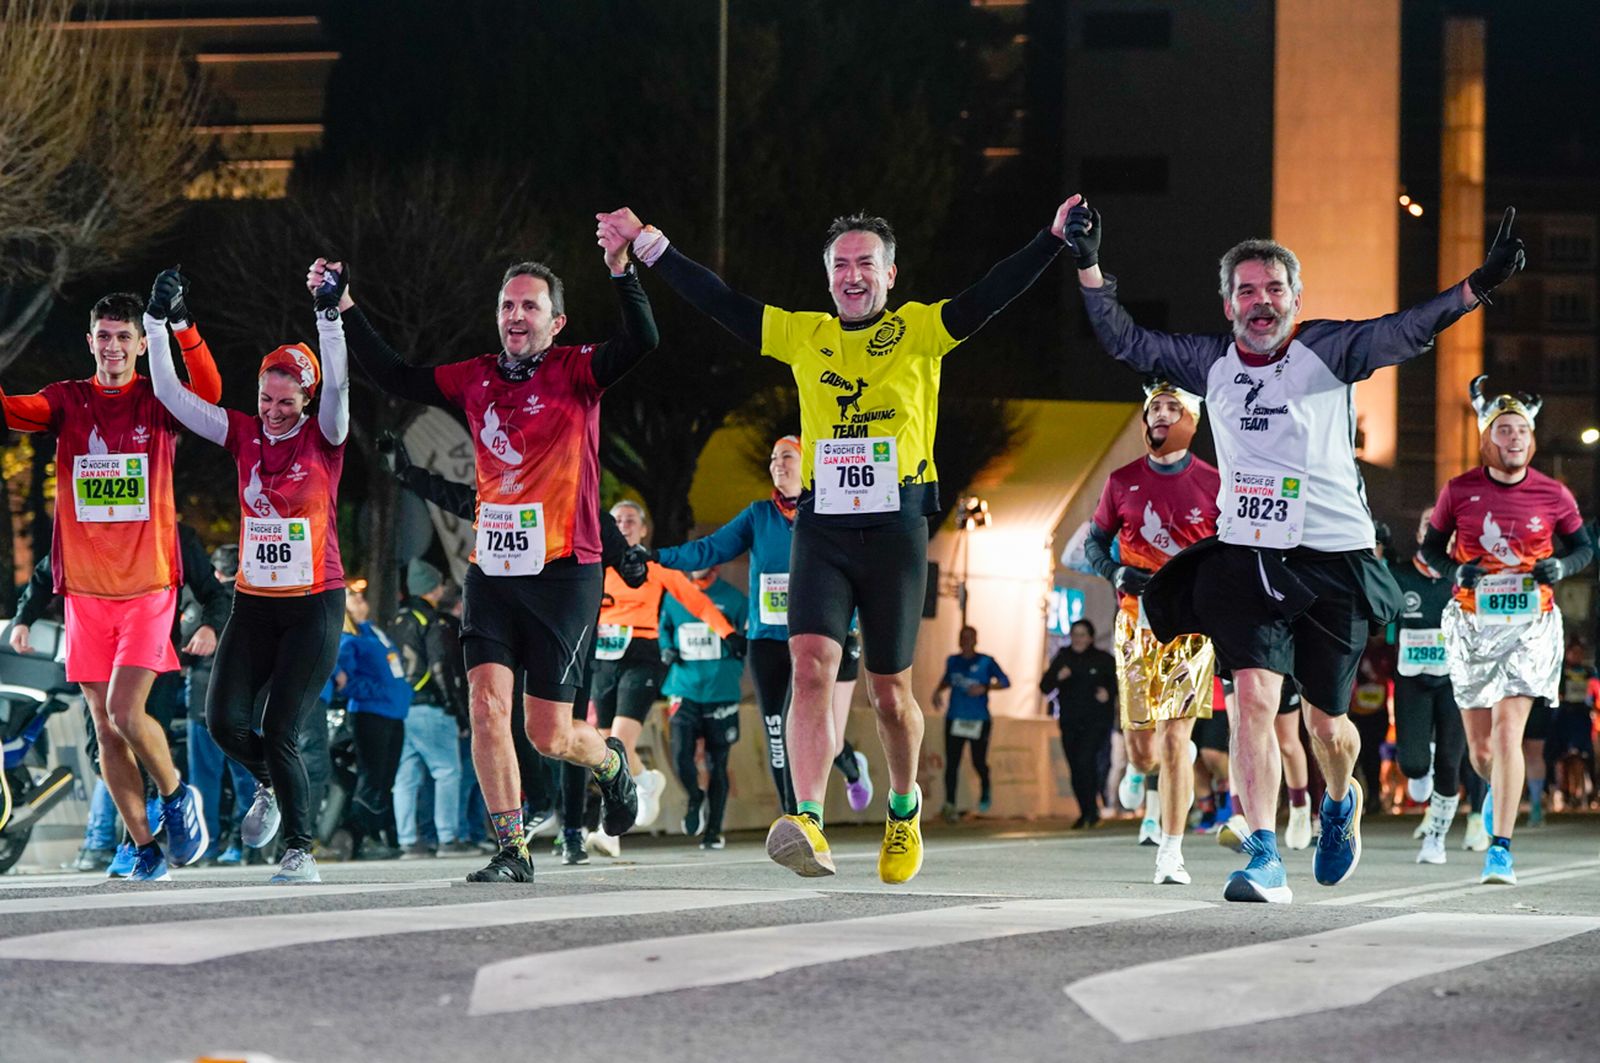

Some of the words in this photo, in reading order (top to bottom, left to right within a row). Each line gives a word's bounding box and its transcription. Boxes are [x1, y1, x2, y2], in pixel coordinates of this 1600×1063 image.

[851, 408, 895, 423] RUNNING
[832, 424, 868, 438] TEAM
[1240, 417, 1268, 431] TEAM
[492, 436, 508, 455] 43
[856, 446, 866, 454] DE
[836, 465, 875, 488] 766
[1242, 477, 1264, 485] NOCHE
[1264, 478, 1276, 487] DE
[82, 478, 139, 498] 12429
[1234, 485, 1248, 494] SAN
[254, 498, 271, 517] 43
[1237, 495, 1288, 522] 3823
[504, 513, 513, 521] DE
[486, 530, 529, 551] 7245
[1152, 533, 1170, 549] 43
[256, 542, 292, 563] 486
[1491, 542, 1508, 557] 43
[1489, 593, 1528, 610] 8799
[1407, 646, 1446, 660] 12982
[765, 714, 785, 769] QUILES
